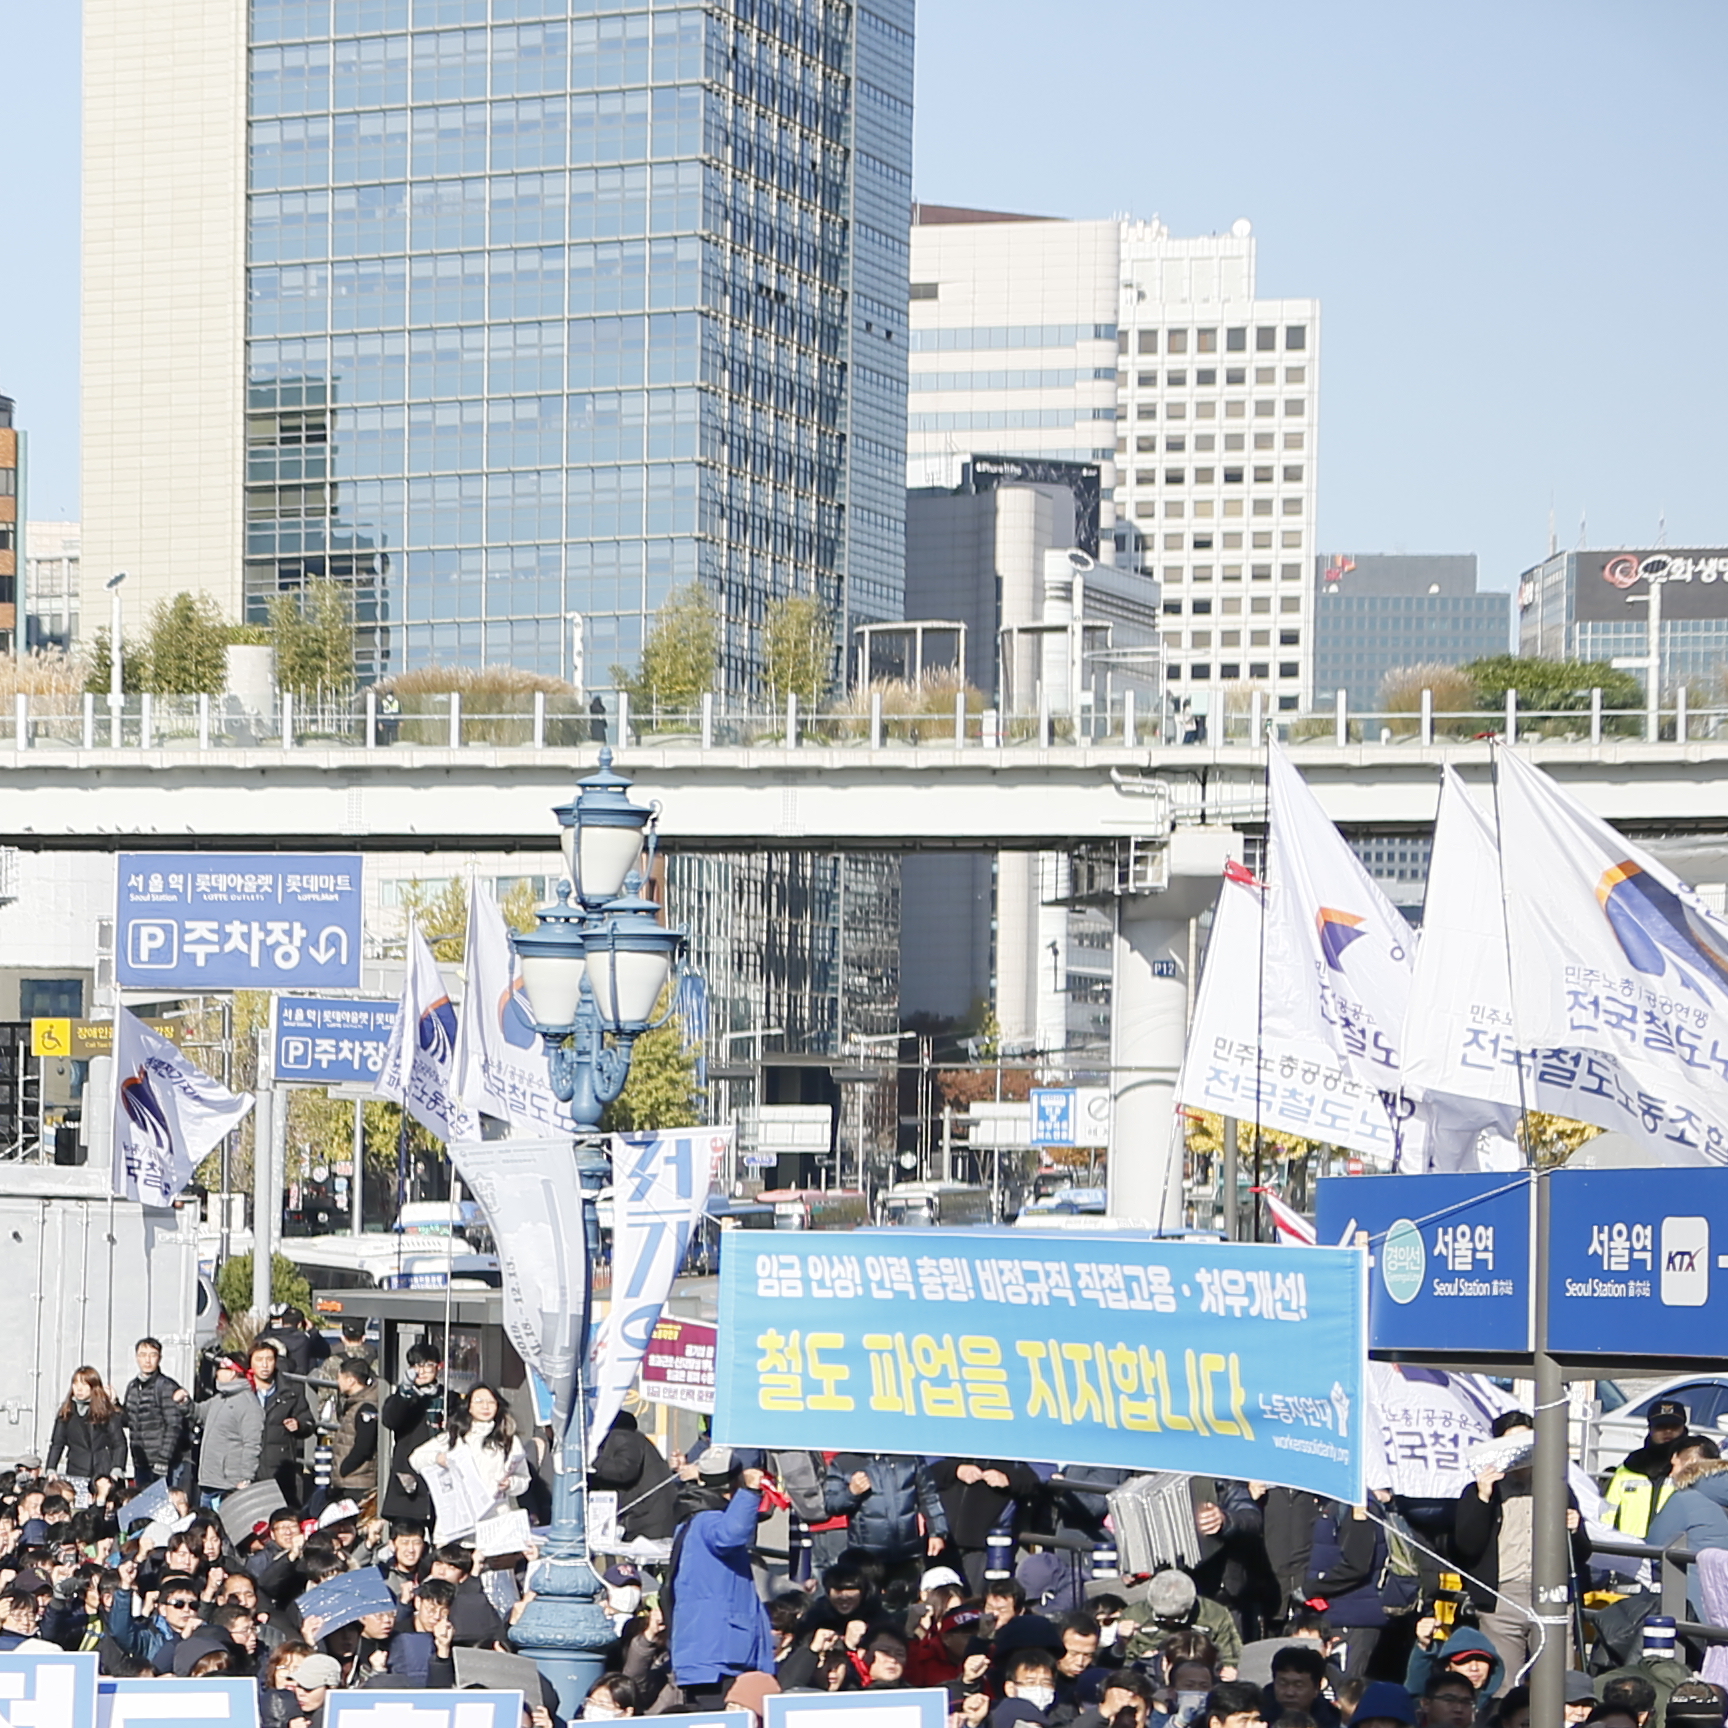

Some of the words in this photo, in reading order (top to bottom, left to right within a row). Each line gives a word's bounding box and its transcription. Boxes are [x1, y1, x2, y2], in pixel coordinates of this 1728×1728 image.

[127, 873, 184, 894] 서울역
[195, 873, 273, 894] 롯데아울렛
[285, 874, 352, 893] 롯데마트
[183, 920, 307, 969] 주차장
[1154, 961, 1175, 976] P12
[1387, 1246, 1421, 1271] 경의선
[1433, 1224, 1494, 1271] 서울역
[1588, 1224, 1653, 1271] 서울역
[1666, 1247, 1707, 1272] KTX
[756, 1253, 802, 1299] 임금
[808, 1255, 864, 1301] 인상!
[868, 1258, 913, 1302] 인력
[917, 1254, 974, 1305] 충원!
[978, 1260, 1077, 1308] 비정규직
[1076, 1263, 1176, 1314] 직접고용
[1196, 1266, 1308, 1321] 처우개선!
[1433, 1279, 1458, 1296] Seoul
[1460, 1279, 1490, 1297] Station
[1565, 1279, 1596, 1297] Seoul
[1598, 1279, 1626, 1297] Station
[756, 1327, 855, 1413] 철도
[862, 1331, 1014, 1422] 파업을
[1015, 1338, 1256, 1441] 지지합니다
[1257, 1394, 1332, 1429] 노동자연대
